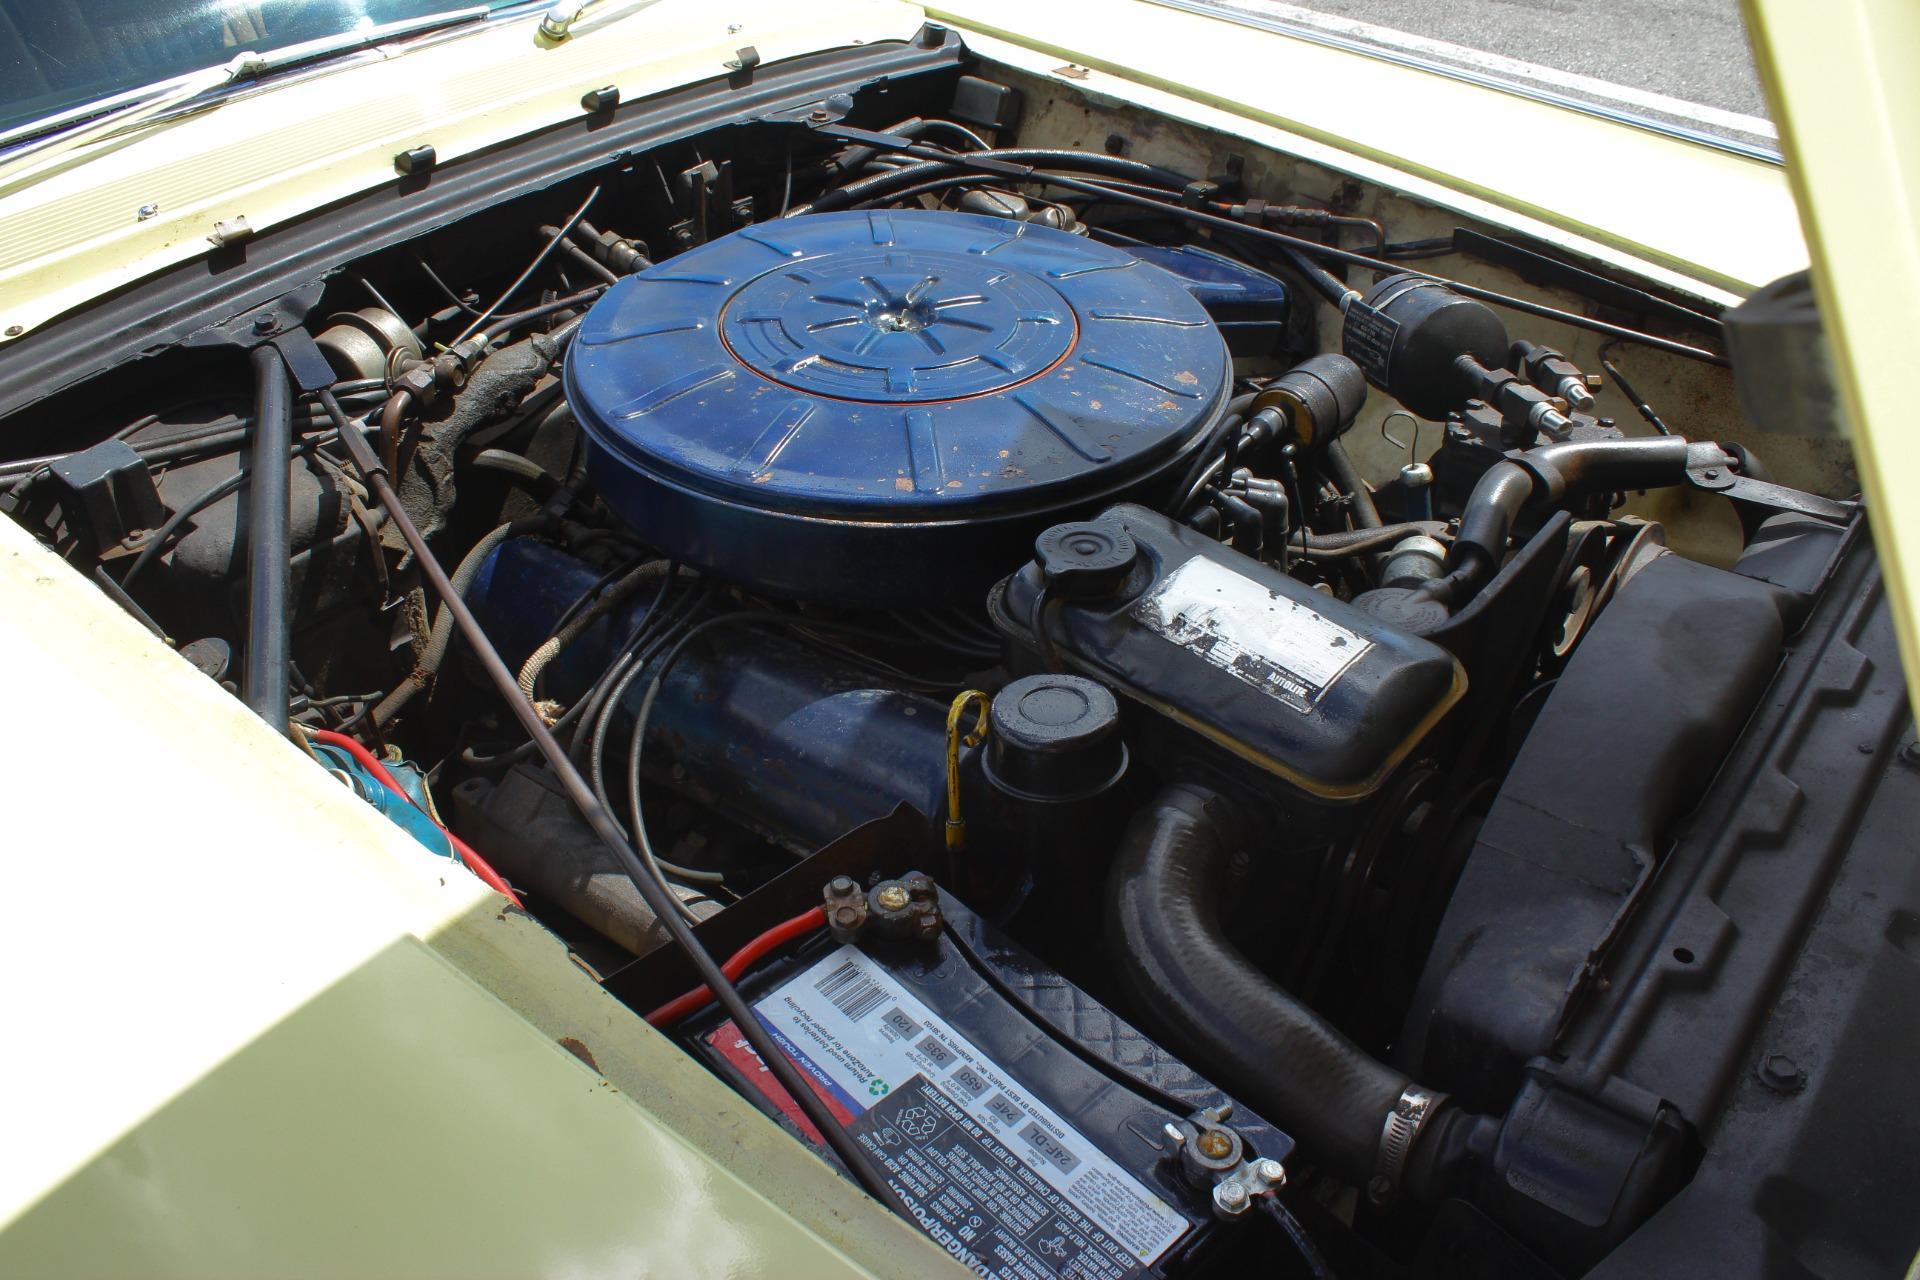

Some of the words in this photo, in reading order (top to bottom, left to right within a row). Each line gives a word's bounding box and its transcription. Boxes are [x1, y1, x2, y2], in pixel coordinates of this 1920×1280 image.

[1267, 671, 1307, 698] AUTOLITE
[782, 997, 813, 1021] recycling
[810, 1022, 834, 1040] proper
[892, 1015, 913, 1032] 120
[771, 1033, 799, 1054] TOUGH
[798, 1024, 829, 1047] batteries
[938, 1033, 948, 1041] TN
[830, 1040, 844, 1050] for
[924, 1042, 947, 1060] 935
[947, 1039, 973, 1062] MEMPHIS,
[826, 1048, 844, 1061] used
[842, 1050, 874, 1076] AutoZone
[796, 1056, 833, 1084] PROVEN
[842, 1063, 867, 1082] Return
[960, 1071, 982, 1090] 650
[986, 1072, 1006, 1089] PARTS,
[920, 1083, 948, 1107] BATTERY!
[1005, 1089, 1020, 1101] BEST
[945, 1105, 963, 1119] OPEN
[993, 1100, 1016, 1119] 24F
[1018, 1099, 1029, 1109] BY
[958, 1116, 975, 1130] NOT
[1028, 1107, 1063, 1138] DISTRIBUTED
[969, 1126, 983, 1137] DO
[857, 1133, 877, 1149] CAUSE
[979, 1134, 995, 1148] TIP.
[1028, 1128, 1069, 1164] 24F-DL
[872, 1147, 888, 1160] CAN
[905, 1148, 925, 1165] BURNS
[926, 1146, 949, 1166] FOLLOW
[953, 1144, 967, 1156] SEEK
[992, 1145, 1007, 1158] NOT
[884, 1158, 901, 1172] ACID
[896, 1154, 909, 1165] OR
[945, 1151, 969, 1171] OWNERS
[1003, 1155, 1018, 1167] DO
[905, 1162, 936, 1189] BLINDNESS
[923, 1164, 944, 1182] SEVERE
[966, 1170, 989, 1190] VEHICLE
[992, 1166, 1026, 1196] ASSISTANCE.
[1015, 1165, 1050, 1195] CHILDREN.
[897, 1170, 928, 1197] SULFURIC
[985, 1187, 997, 1197] IN
[992, 1178, 1007, 1191] NOT
[1002, 1188, 1013, 1196] IF
[946, 1185, 971, 1207] SMOKING
[971, 1187, 989, 1202] JUMP
[1008, 1193, 1021, 1204] OR
[1046, 1192, 1060, 1204] OF
[929, 1200, 954, 1221] SPARKS
[939, 1194, 963, 1214] FLAMES
[985, 1199, 1000, 1212] FOR
[994, 1194, 1033, 1228] INSTRUCTIONS
[1016, 1201, 1040, 1222] MANUAL
[1024, 1194, 1048, 1215] SERVICE
[1056, 1201, 1080, 1221] REACH
[998, 1211, 1025, 1235] CAUTION:
[1053, 1218, 1071, 1234] FAST.
[1078, 1219, 1094, 1233] THE
[958, 1225, 976, 1240] NO
[994, 1228, 1016, 1248] INJURY
[1069, 1232, 1086, 1247] HELP
[1090, 1229, 1105, 1242] OF
[994, 1244, 1017, 1264] GASES
[1012, 1245, 1026, 1257] OR
[1102, 1239, 1118, 1253] OUT
[1075, 1251, 1099, 1272] WATER.
[1083, 1244, 1110, 1268] MEDICAL
[1116, 1251, 1135, 1267] KEEP
[1108, 1266, 1122, 1278] GET
